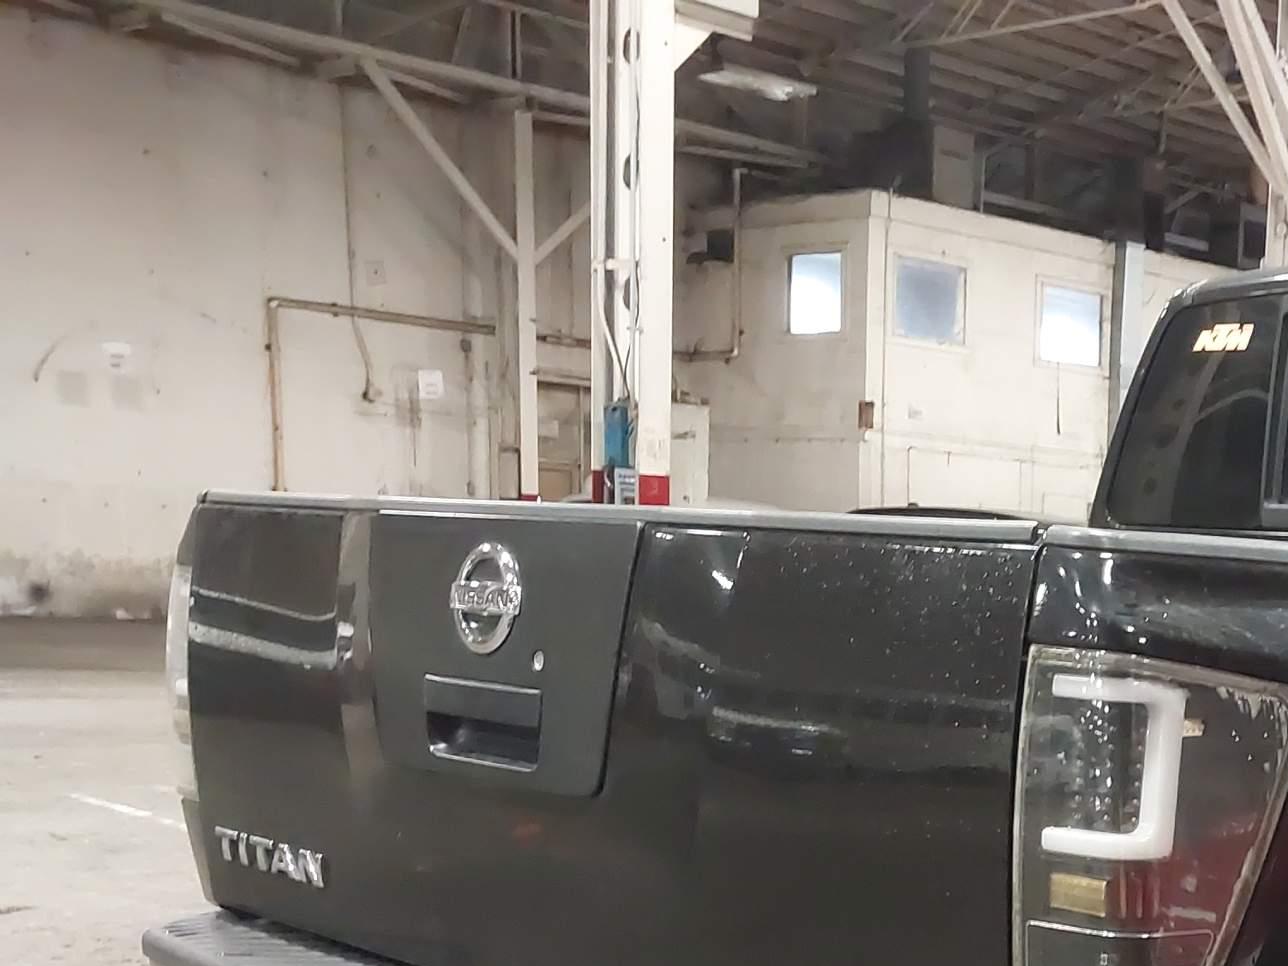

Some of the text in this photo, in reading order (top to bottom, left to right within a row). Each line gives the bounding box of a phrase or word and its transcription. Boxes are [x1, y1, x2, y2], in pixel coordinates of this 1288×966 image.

[1192, 323, 1255, 352] KTM
[454, 586, 511, 611] NISSAN
[214, 825, 325, 888] TITAN
